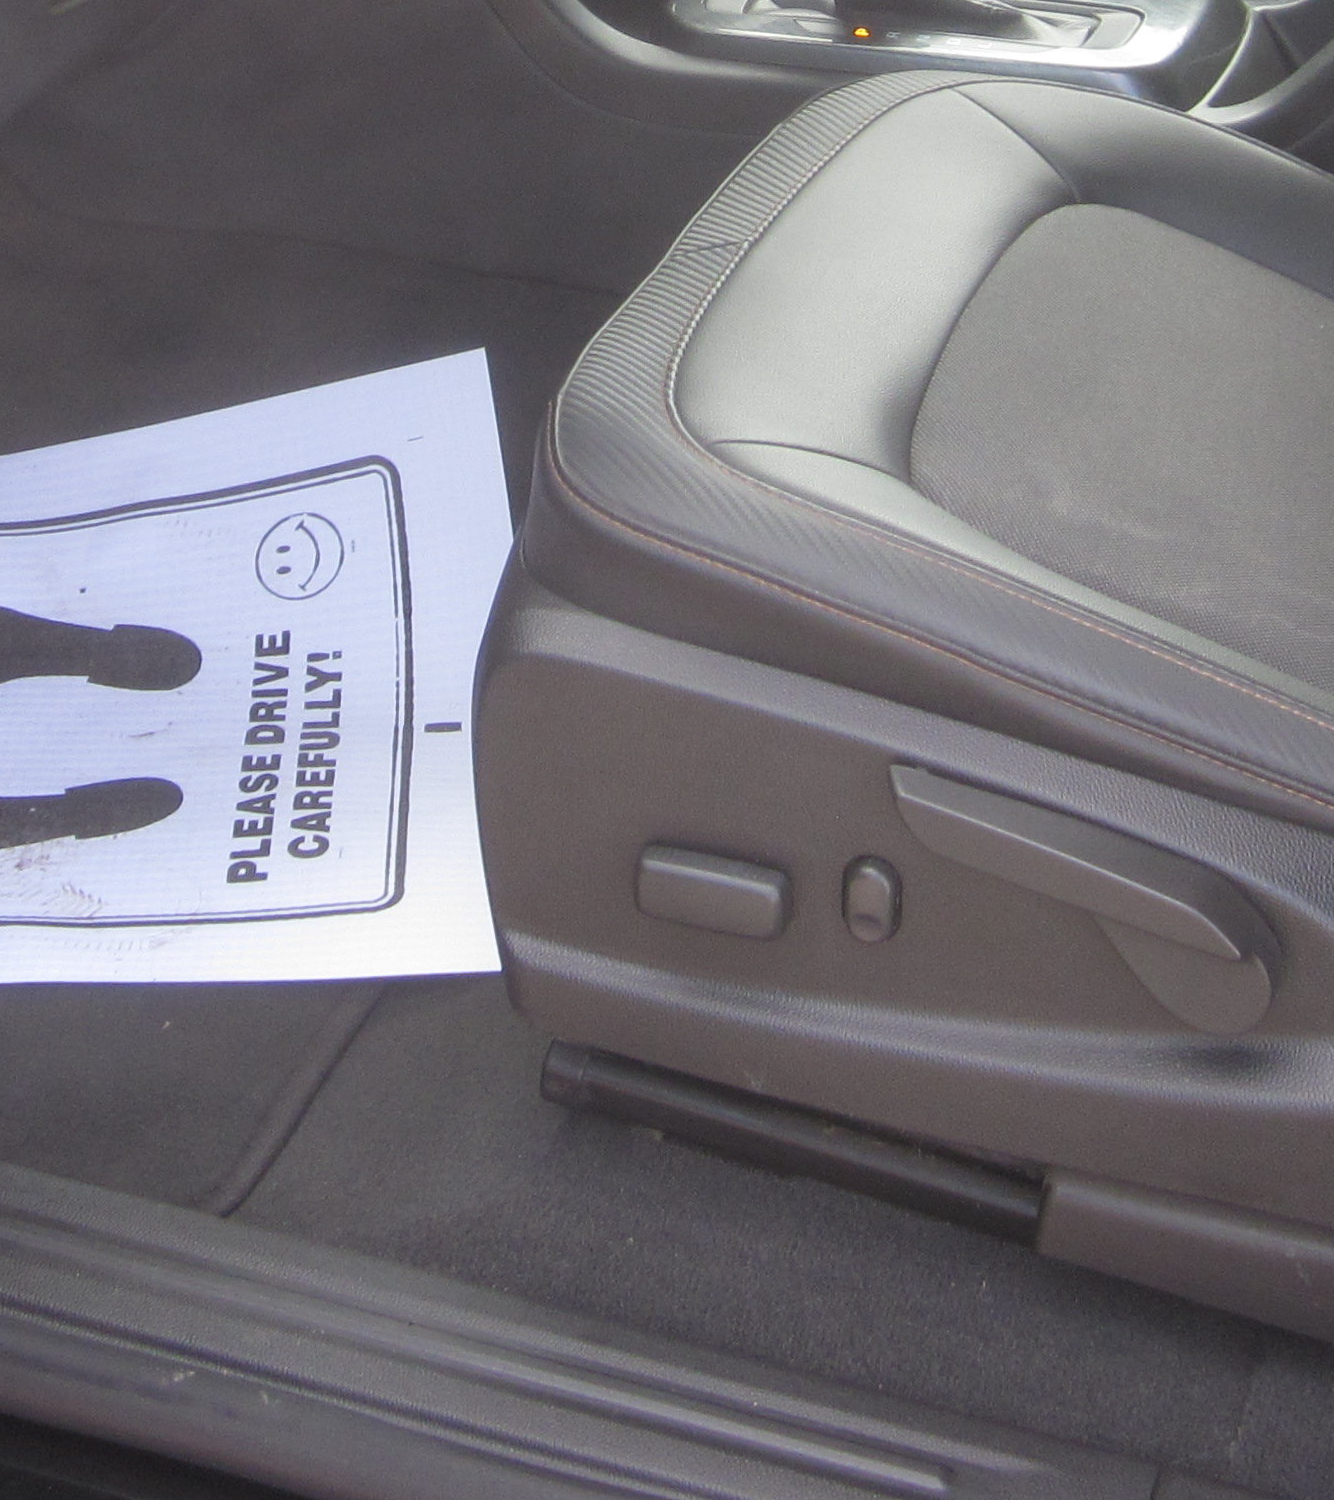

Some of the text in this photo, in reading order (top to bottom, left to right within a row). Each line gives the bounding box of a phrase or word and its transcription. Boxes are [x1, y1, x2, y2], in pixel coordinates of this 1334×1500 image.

[226, 630, 291, 884] PLEASE DRIVE
[287, 650, 343, 859] CAREFULLY!
